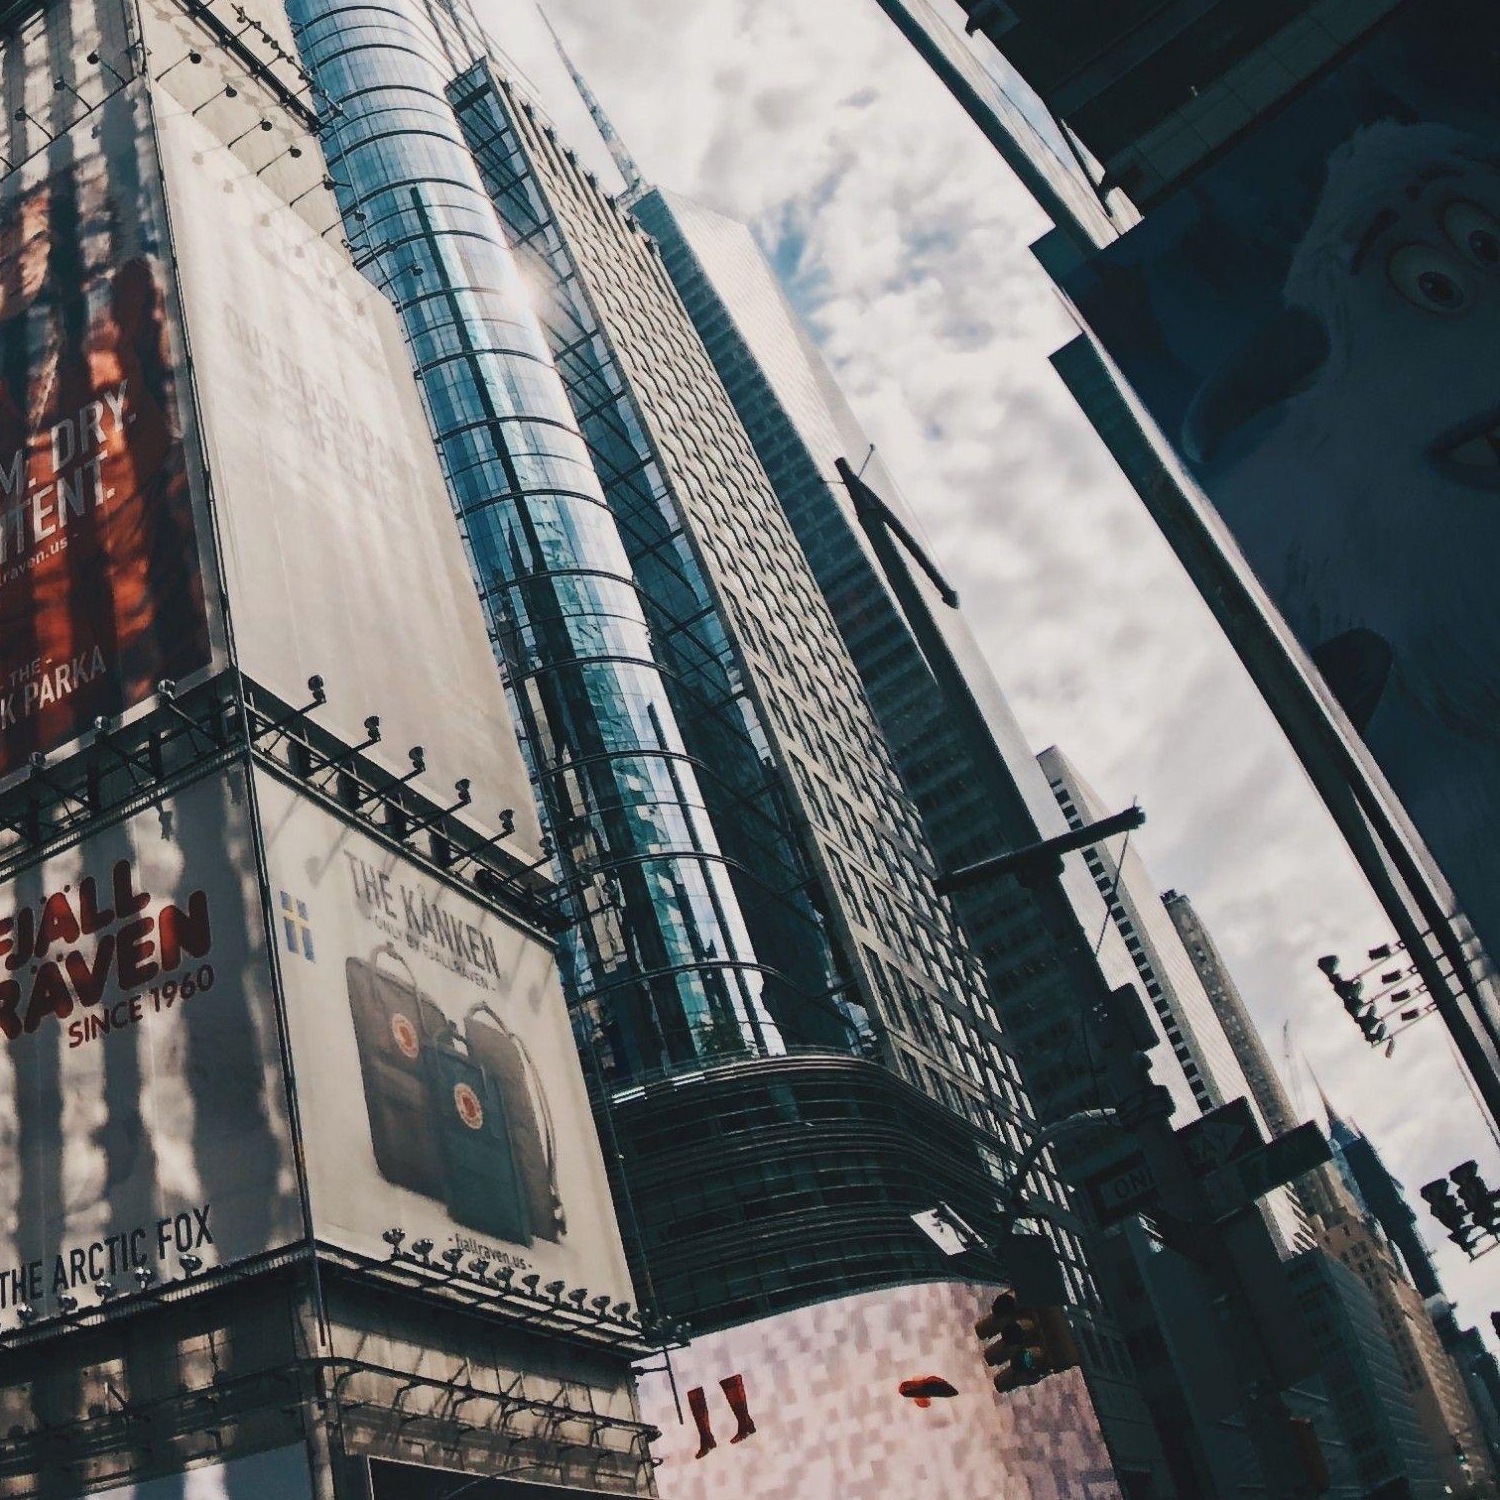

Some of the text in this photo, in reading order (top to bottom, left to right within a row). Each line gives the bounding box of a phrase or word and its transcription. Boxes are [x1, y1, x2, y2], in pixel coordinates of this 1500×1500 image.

[50, 378, 138, 475] DRY.
[8, 657, 43, 688] THE
[24, 644, 108, 718] PARKA
[343, 848, 398, 920] THE
[66, 961, 217, 1050] SINCE 1960
[51, 1227, 148, 1293] ARCTIC
[157, 1203, 214, 1261] FOX
